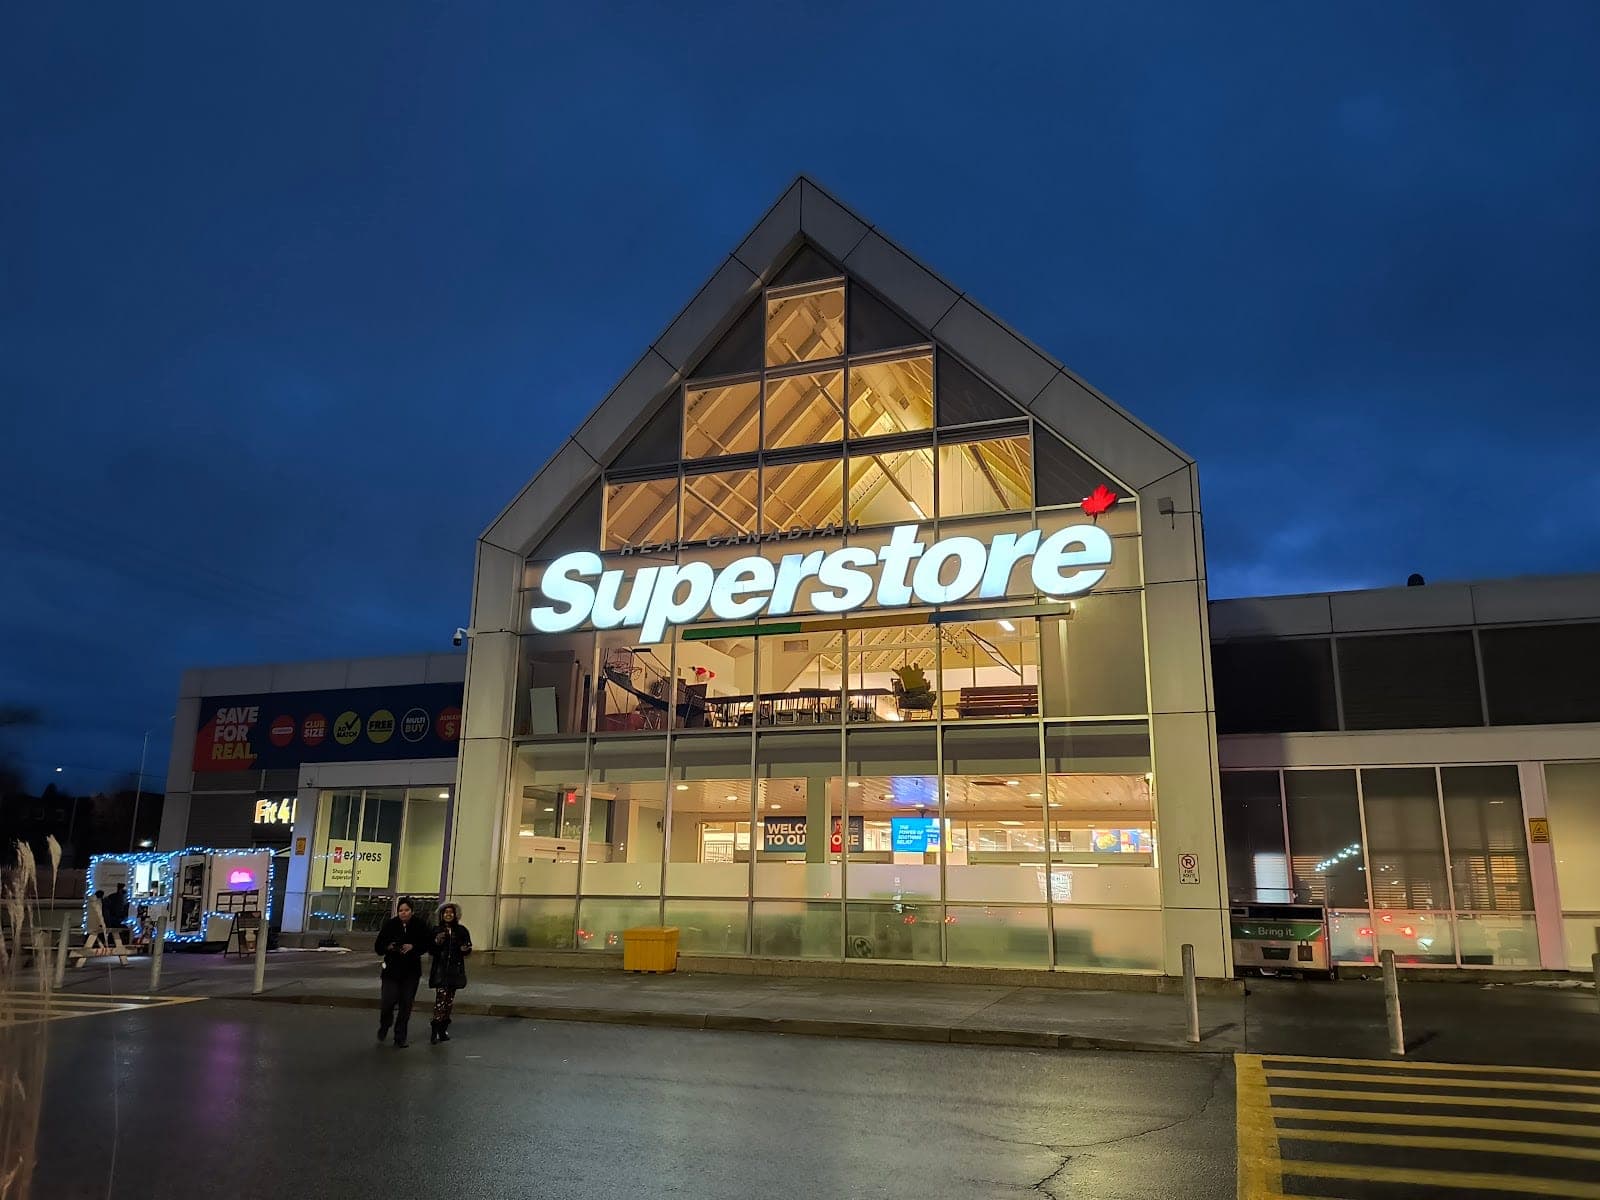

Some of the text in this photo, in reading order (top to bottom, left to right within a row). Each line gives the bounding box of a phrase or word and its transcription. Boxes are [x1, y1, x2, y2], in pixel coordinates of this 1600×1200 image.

[620, 519, 859, 556] REAL CANADIAN
[530, 524, 1113, 644] Superstore
[216, 706, 259, 724] SAVE
[368, 720, 393, 730] FREE
[405, 724, 424, 733] BUY
[214, 725, 249, 742] FOR
[304, 728, 325, 738] SIZE
[767, 835, 784, 845] TO
[787, 835, 805, 845] OU
[1258, 927, 1284, 938] Bring
